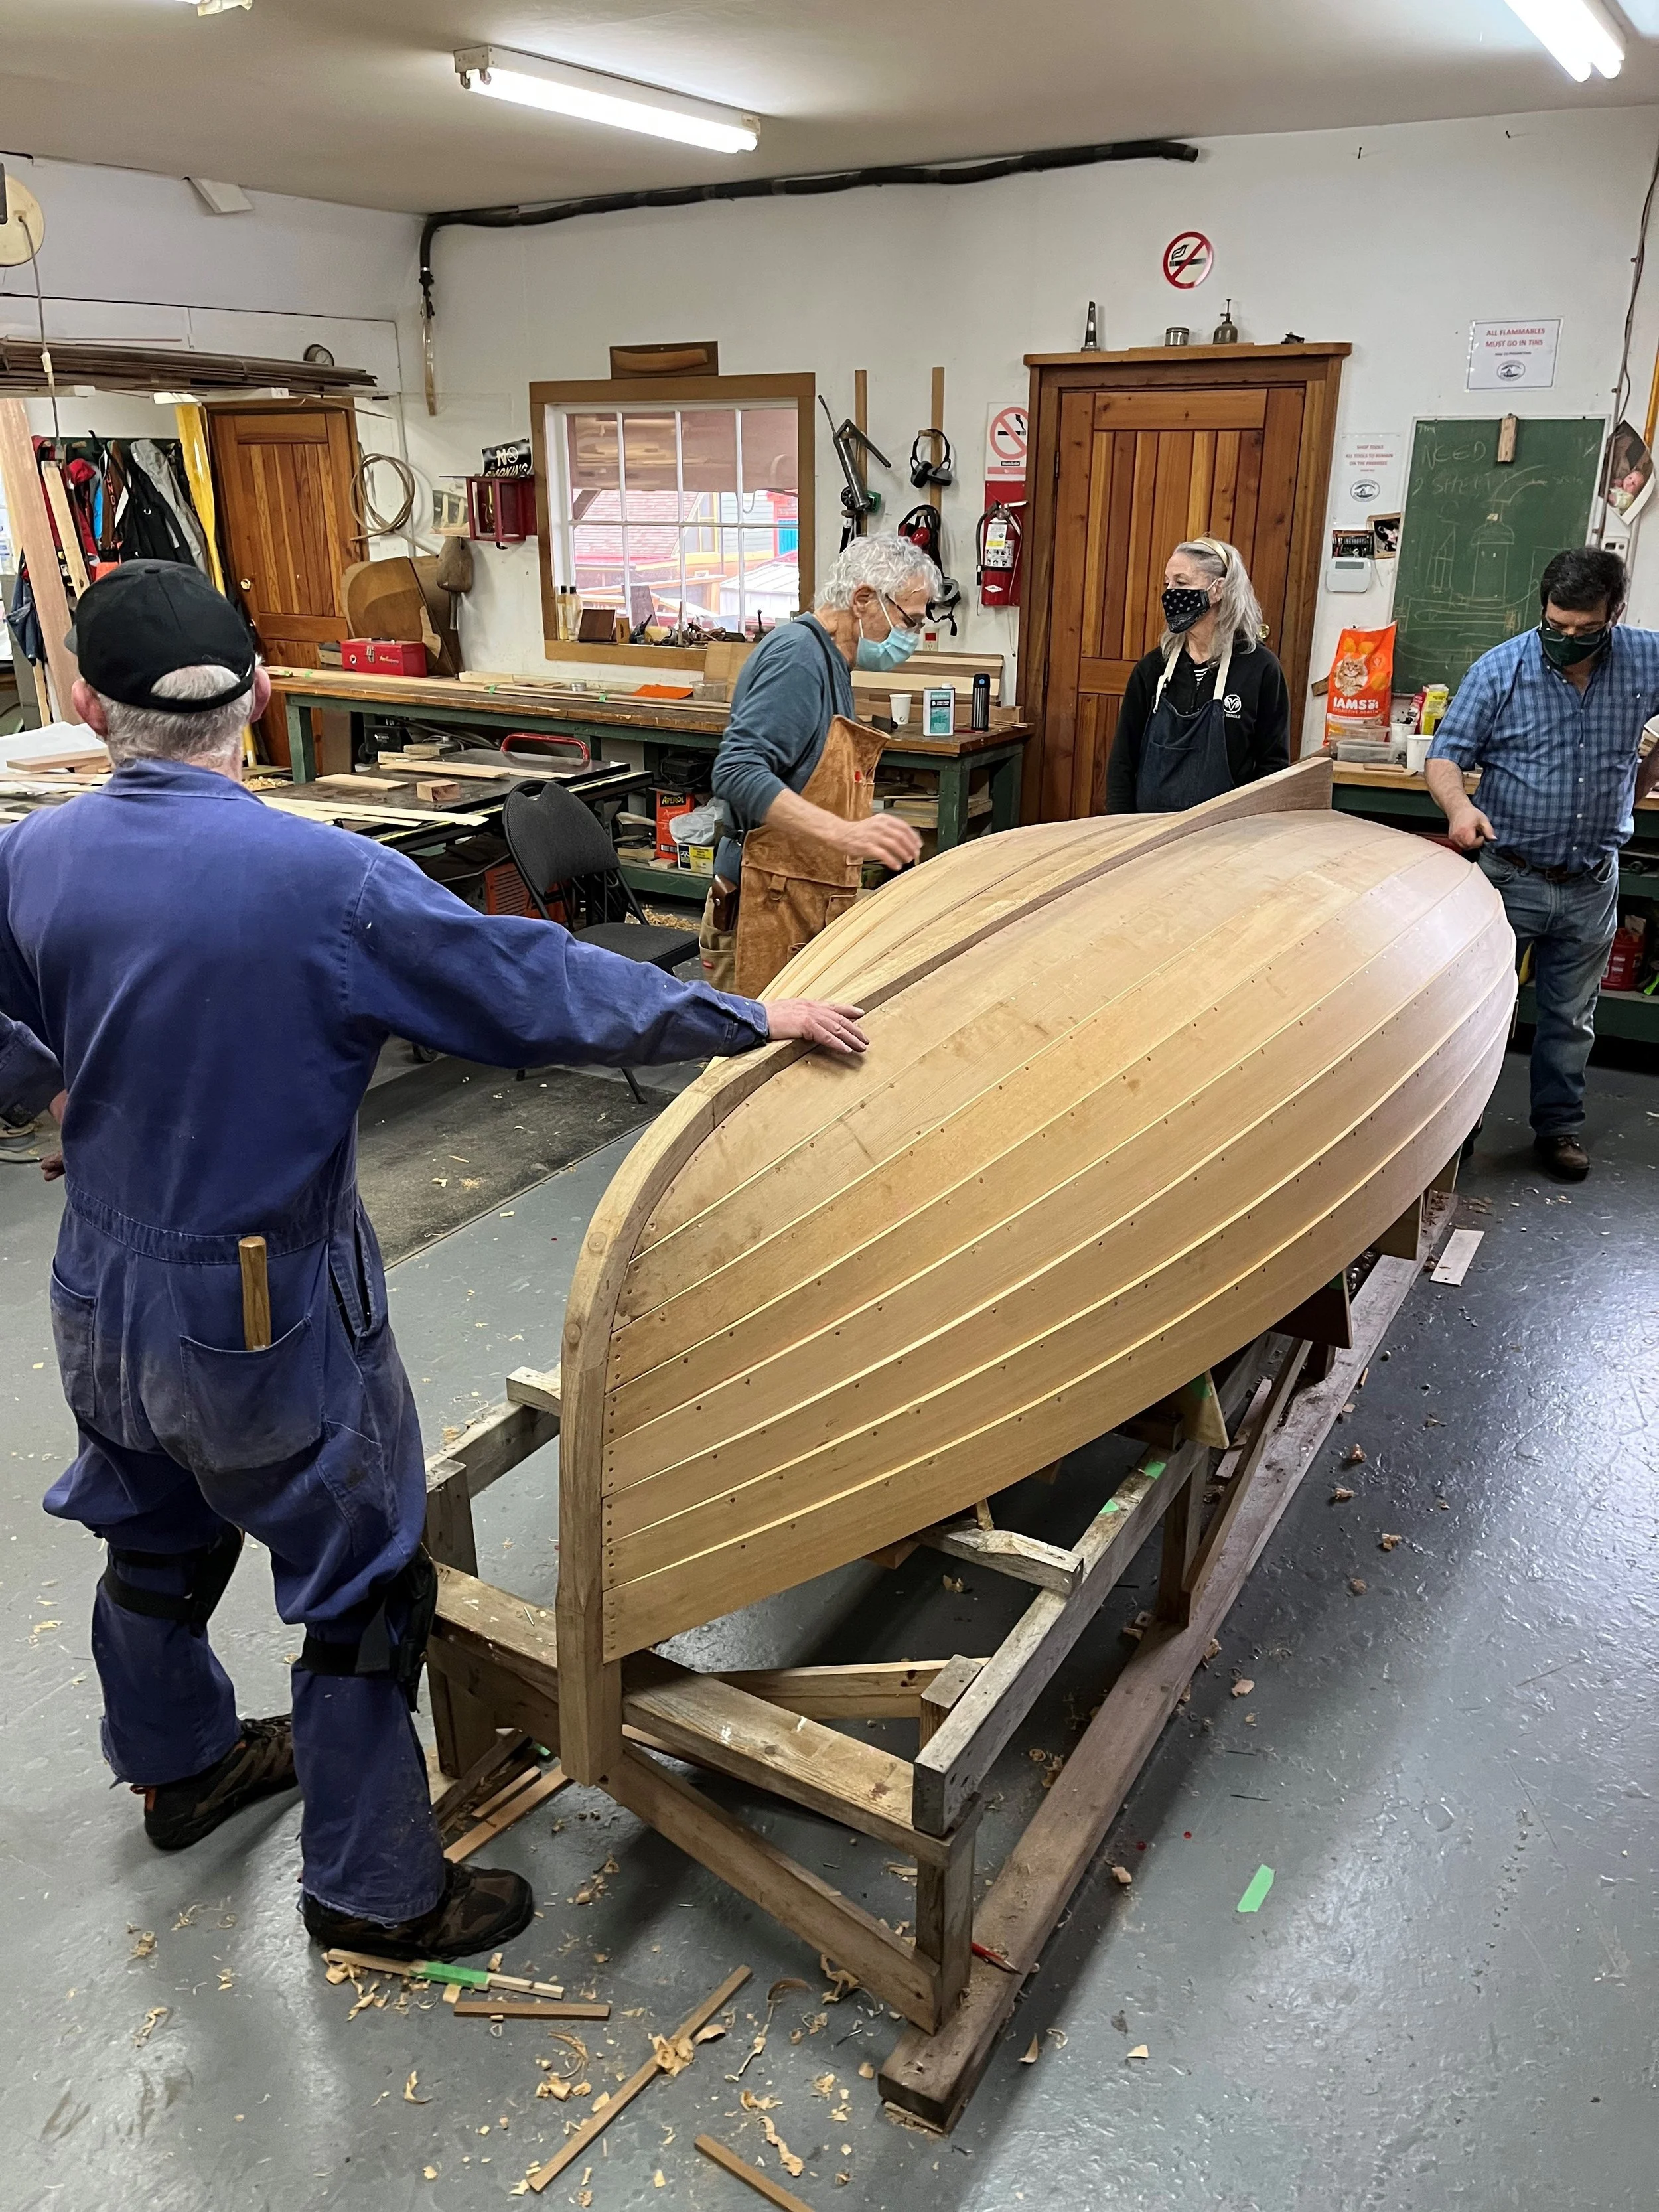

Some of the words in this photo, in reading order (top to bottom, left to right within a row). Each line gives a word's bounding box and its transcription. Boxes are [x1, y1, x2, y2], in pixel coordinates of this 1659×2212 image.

[1486, 340, 1506, 348] MUST
[496, 446, 519, 467] NO
[1422, 440, 1486, 471] NEED
[1333, 696, 1367, 711] IAMS
